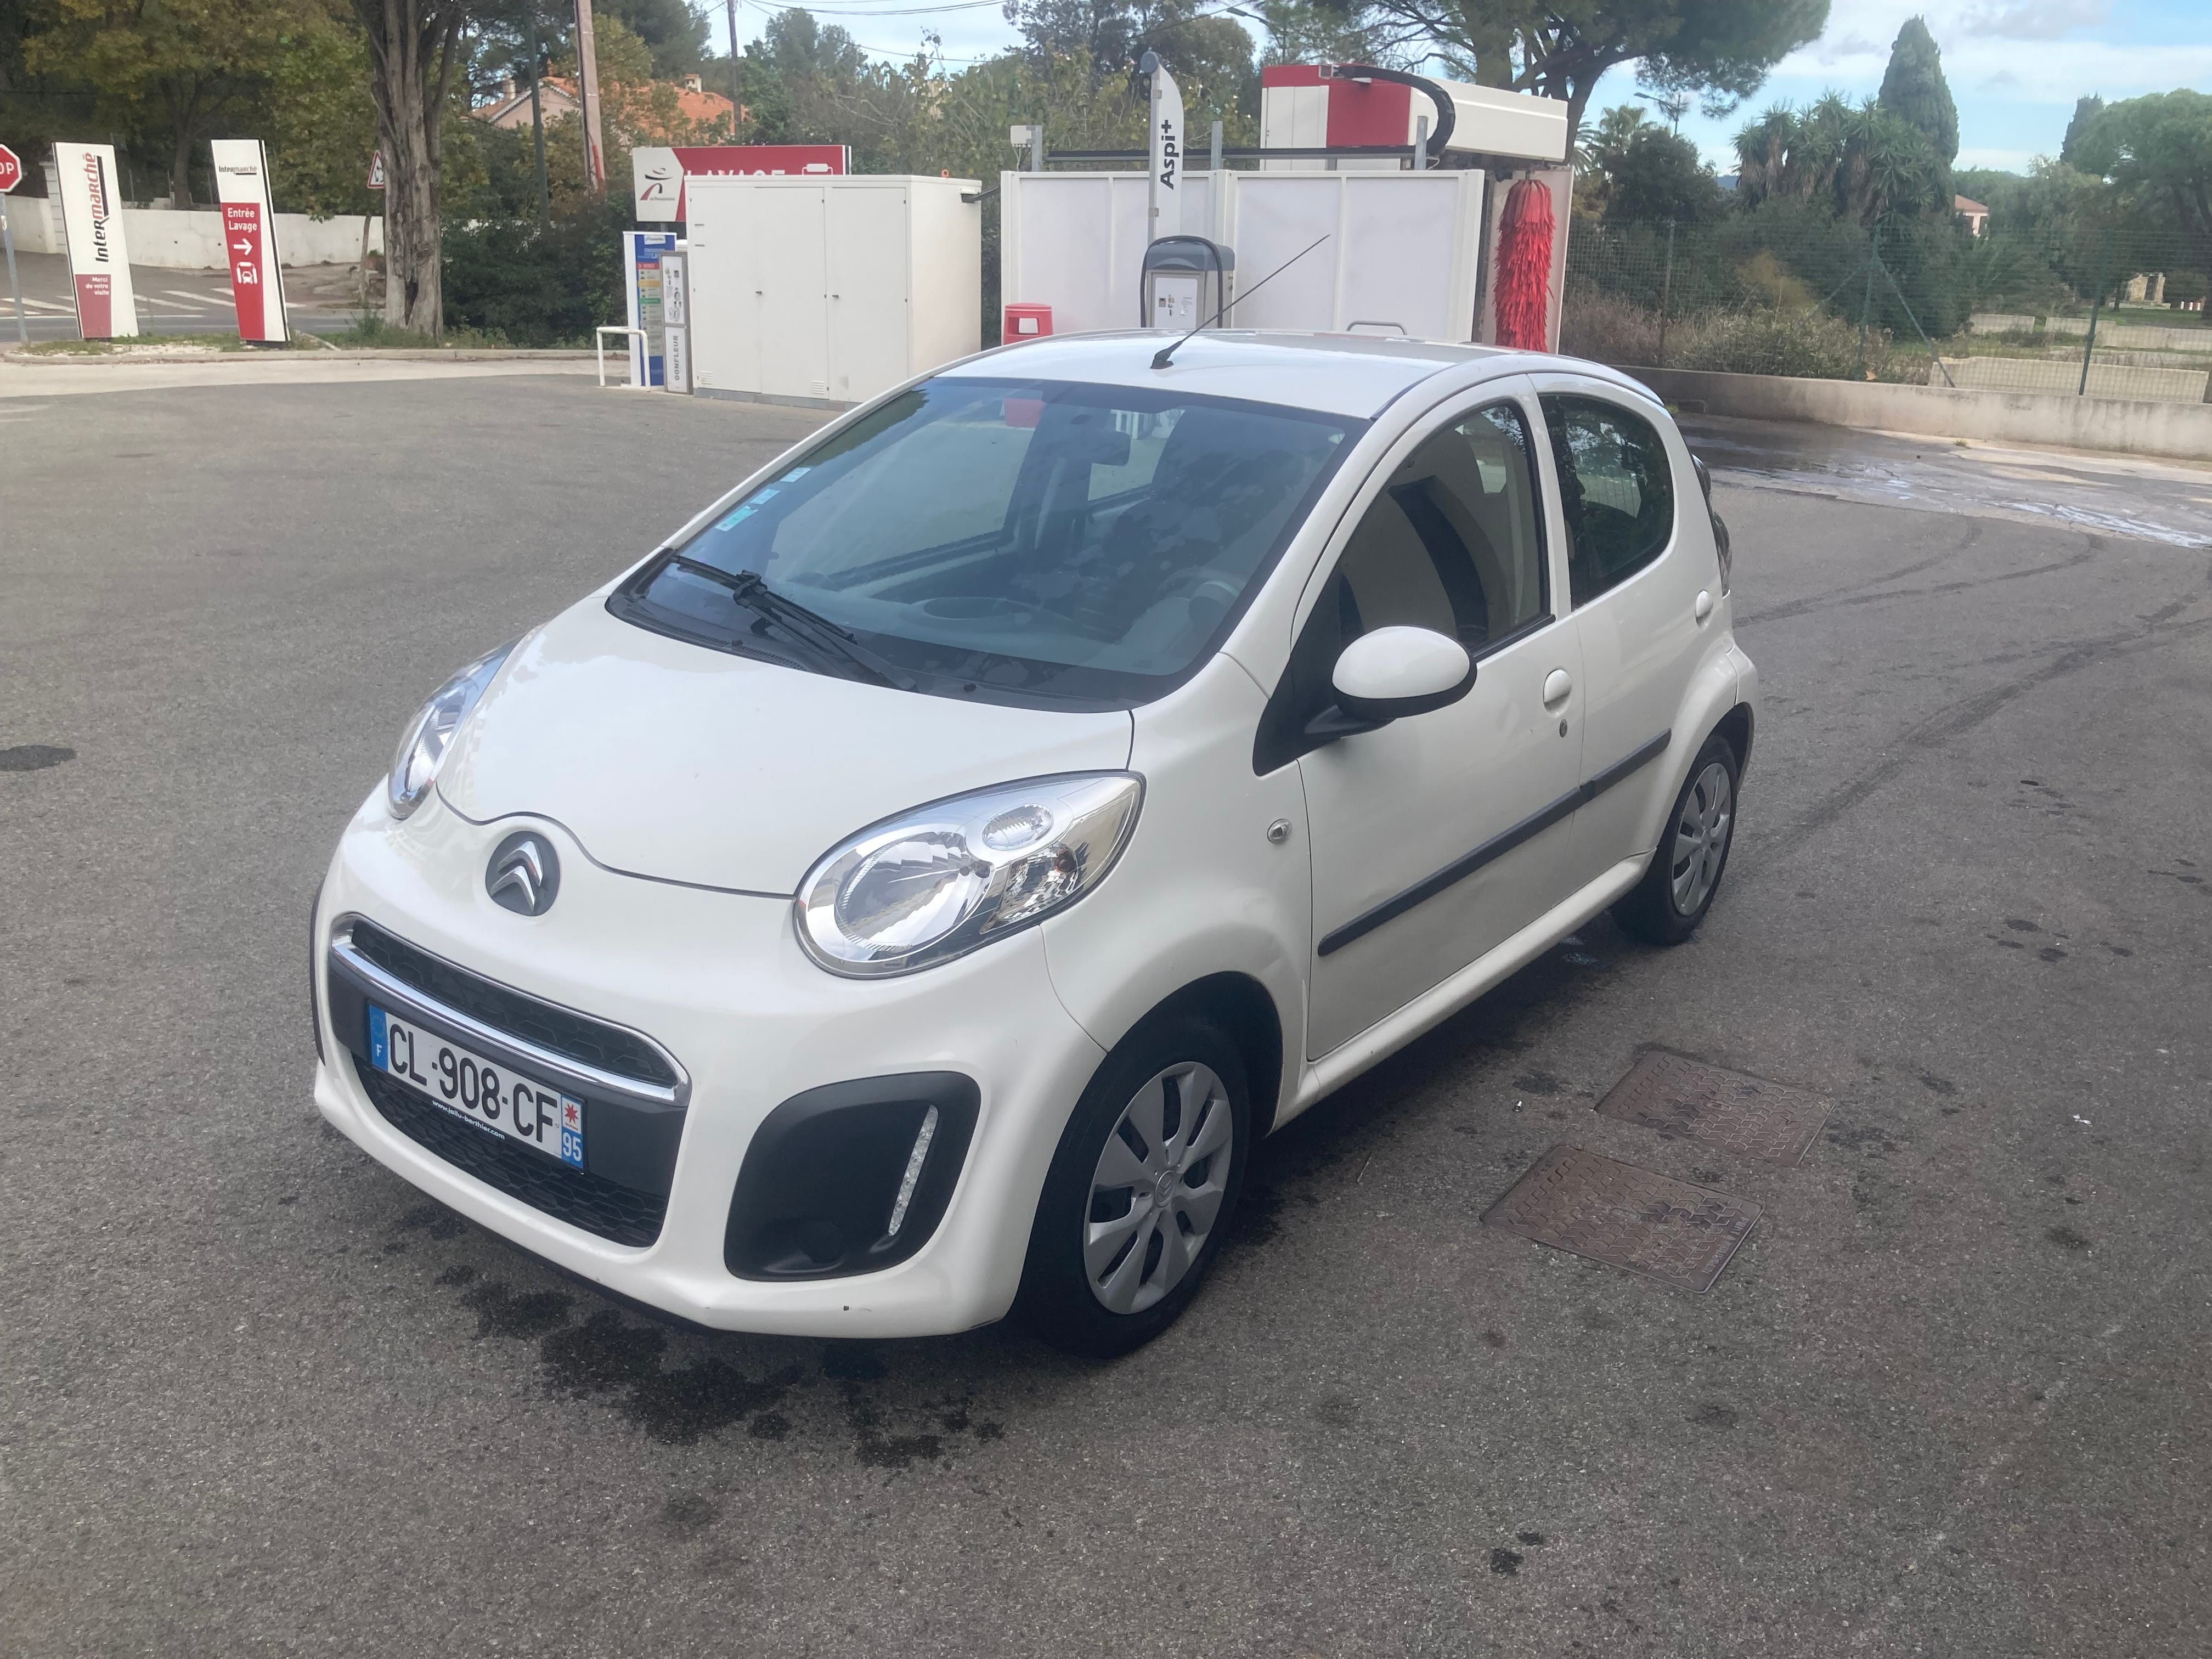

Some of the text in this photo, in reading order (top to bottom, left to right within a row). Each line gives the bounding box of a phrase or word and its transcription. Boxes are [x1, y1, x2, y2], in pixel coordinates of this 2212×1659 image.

[1160, 120, 1179, 190] Aspi+
[228, 207, 255, 218] Entrée
[229, 221, 257, 233] Lavage
[376, 1043, 383, 1057] F
[390, 1024, 557, 1143] CL-908-CF
[563, 1132, 582, 1162] 95
